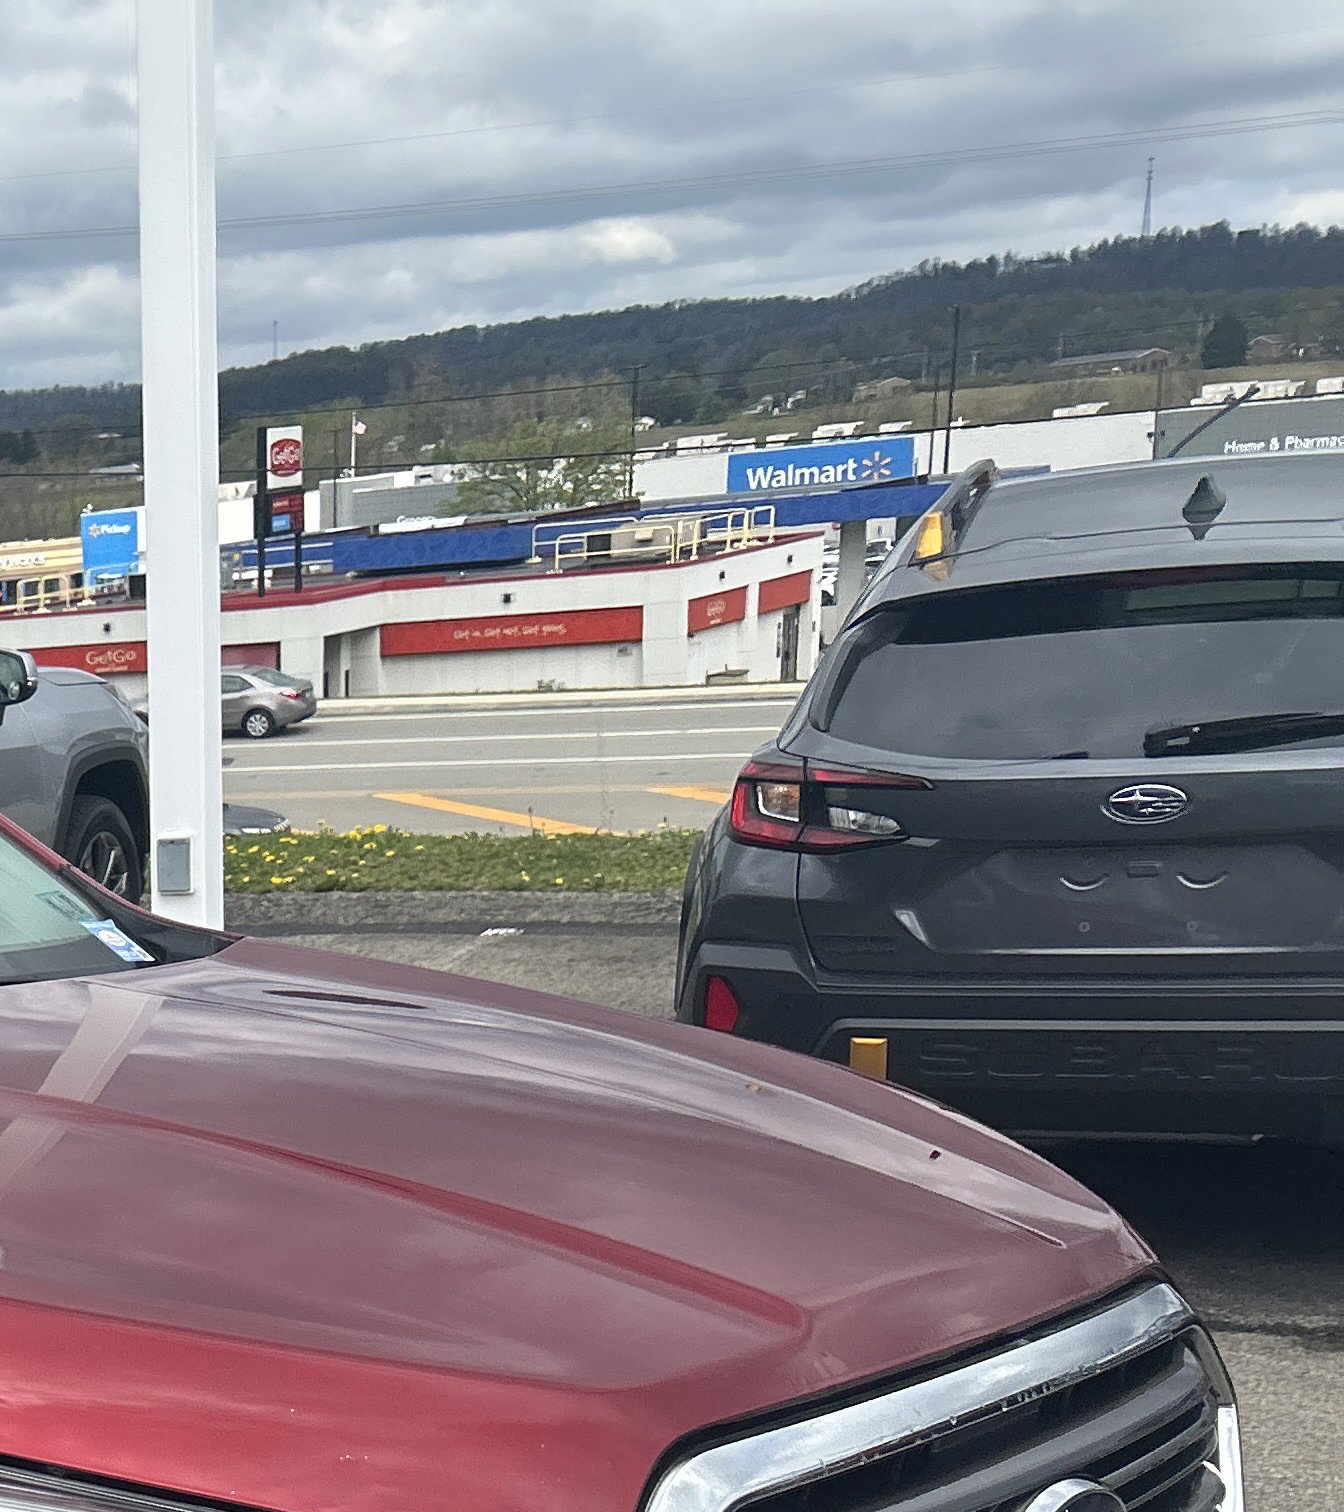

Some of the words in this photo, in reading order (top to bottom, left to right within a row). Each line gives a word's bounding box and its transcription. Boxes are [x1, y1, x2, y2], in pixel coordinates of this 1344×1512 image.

[1269, 436, 1280, 451] &
[747, 458, 858, 490] Walmart
[85, 648, 138, 666] GetGo
